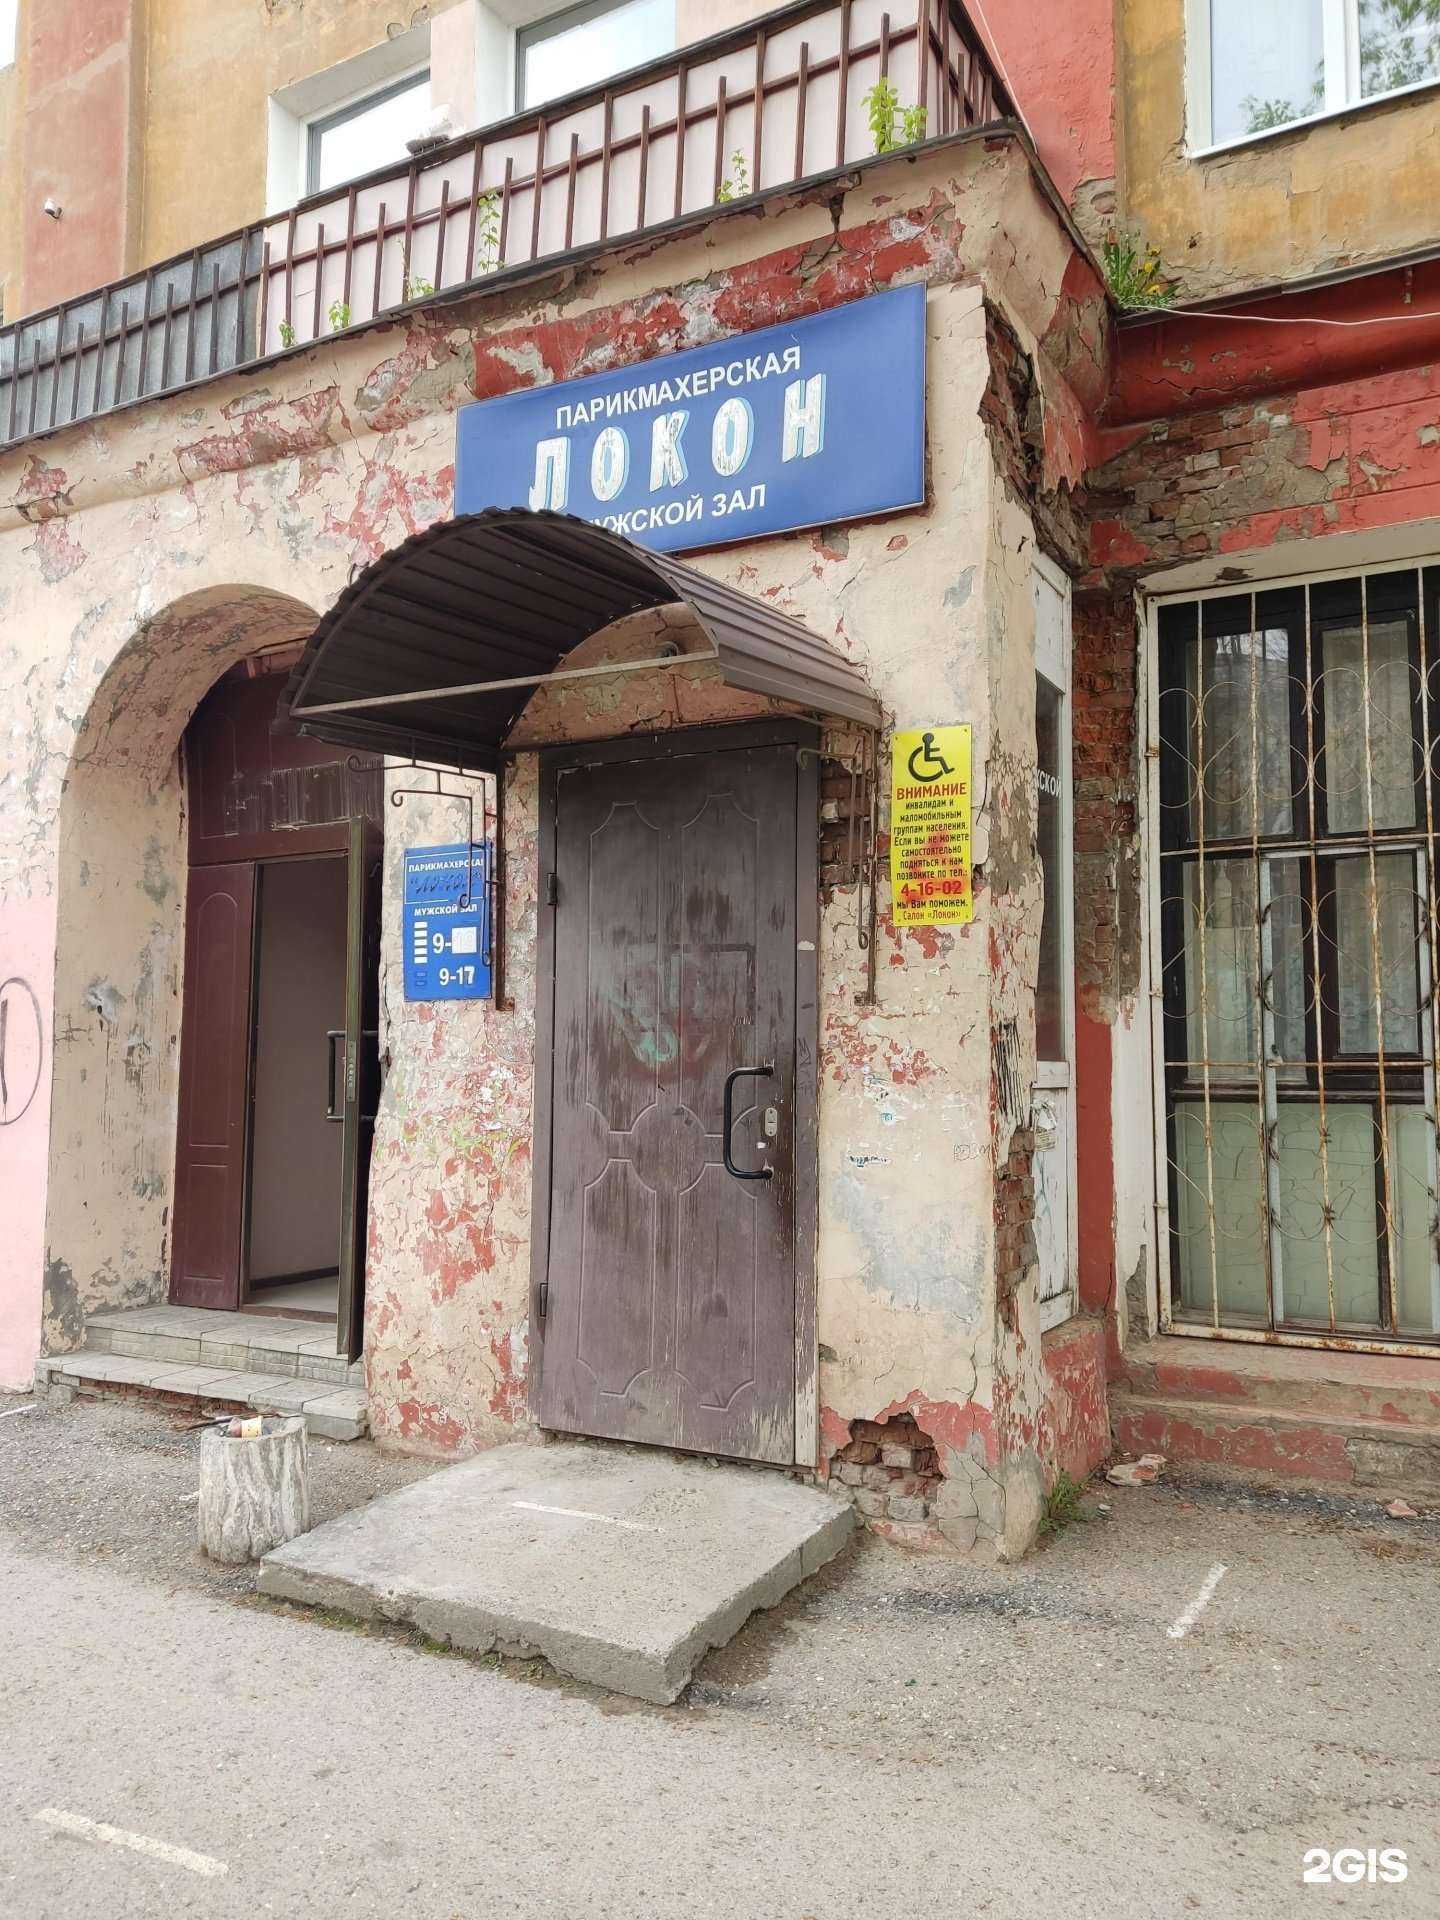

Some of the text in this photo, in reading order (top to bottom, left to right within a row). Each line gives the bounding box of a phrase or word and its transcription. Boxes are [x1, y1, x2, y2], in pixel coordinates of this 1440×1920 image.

[556, 346, 801, 430] ПАРИКМАХЕРСКАЯ
[528, 373, 826, 512] ЛОКОН
[589, 484, 767, 535] УЖСКОЙ ЗАЛ
[896, 782, 967, 800] ВНИМАНИЕ
[906, 799, 954, 810] инвалидам и
[900, 811, 962, 823] маломобильным
[893, 825, 923, 836] группам
[894, 833, 969, 847] Если вы не можете
[902, 845, 962, 857] самостоятельно
[900, 859, 939, 870] подняться
[949, 857, 964, 866] нам
[896, 870, 935, 881] позвоните
[937, 869, 947, 878] по
[901, 880, 962, 896] 4-16-02
[414, 903, 458, 917] МУЖСКОЙ
[896, 898, 968, 909] мы Вам поможем.
[903, 910, 925, 920] Салон
[439, 965, 476, 986] 9-17
